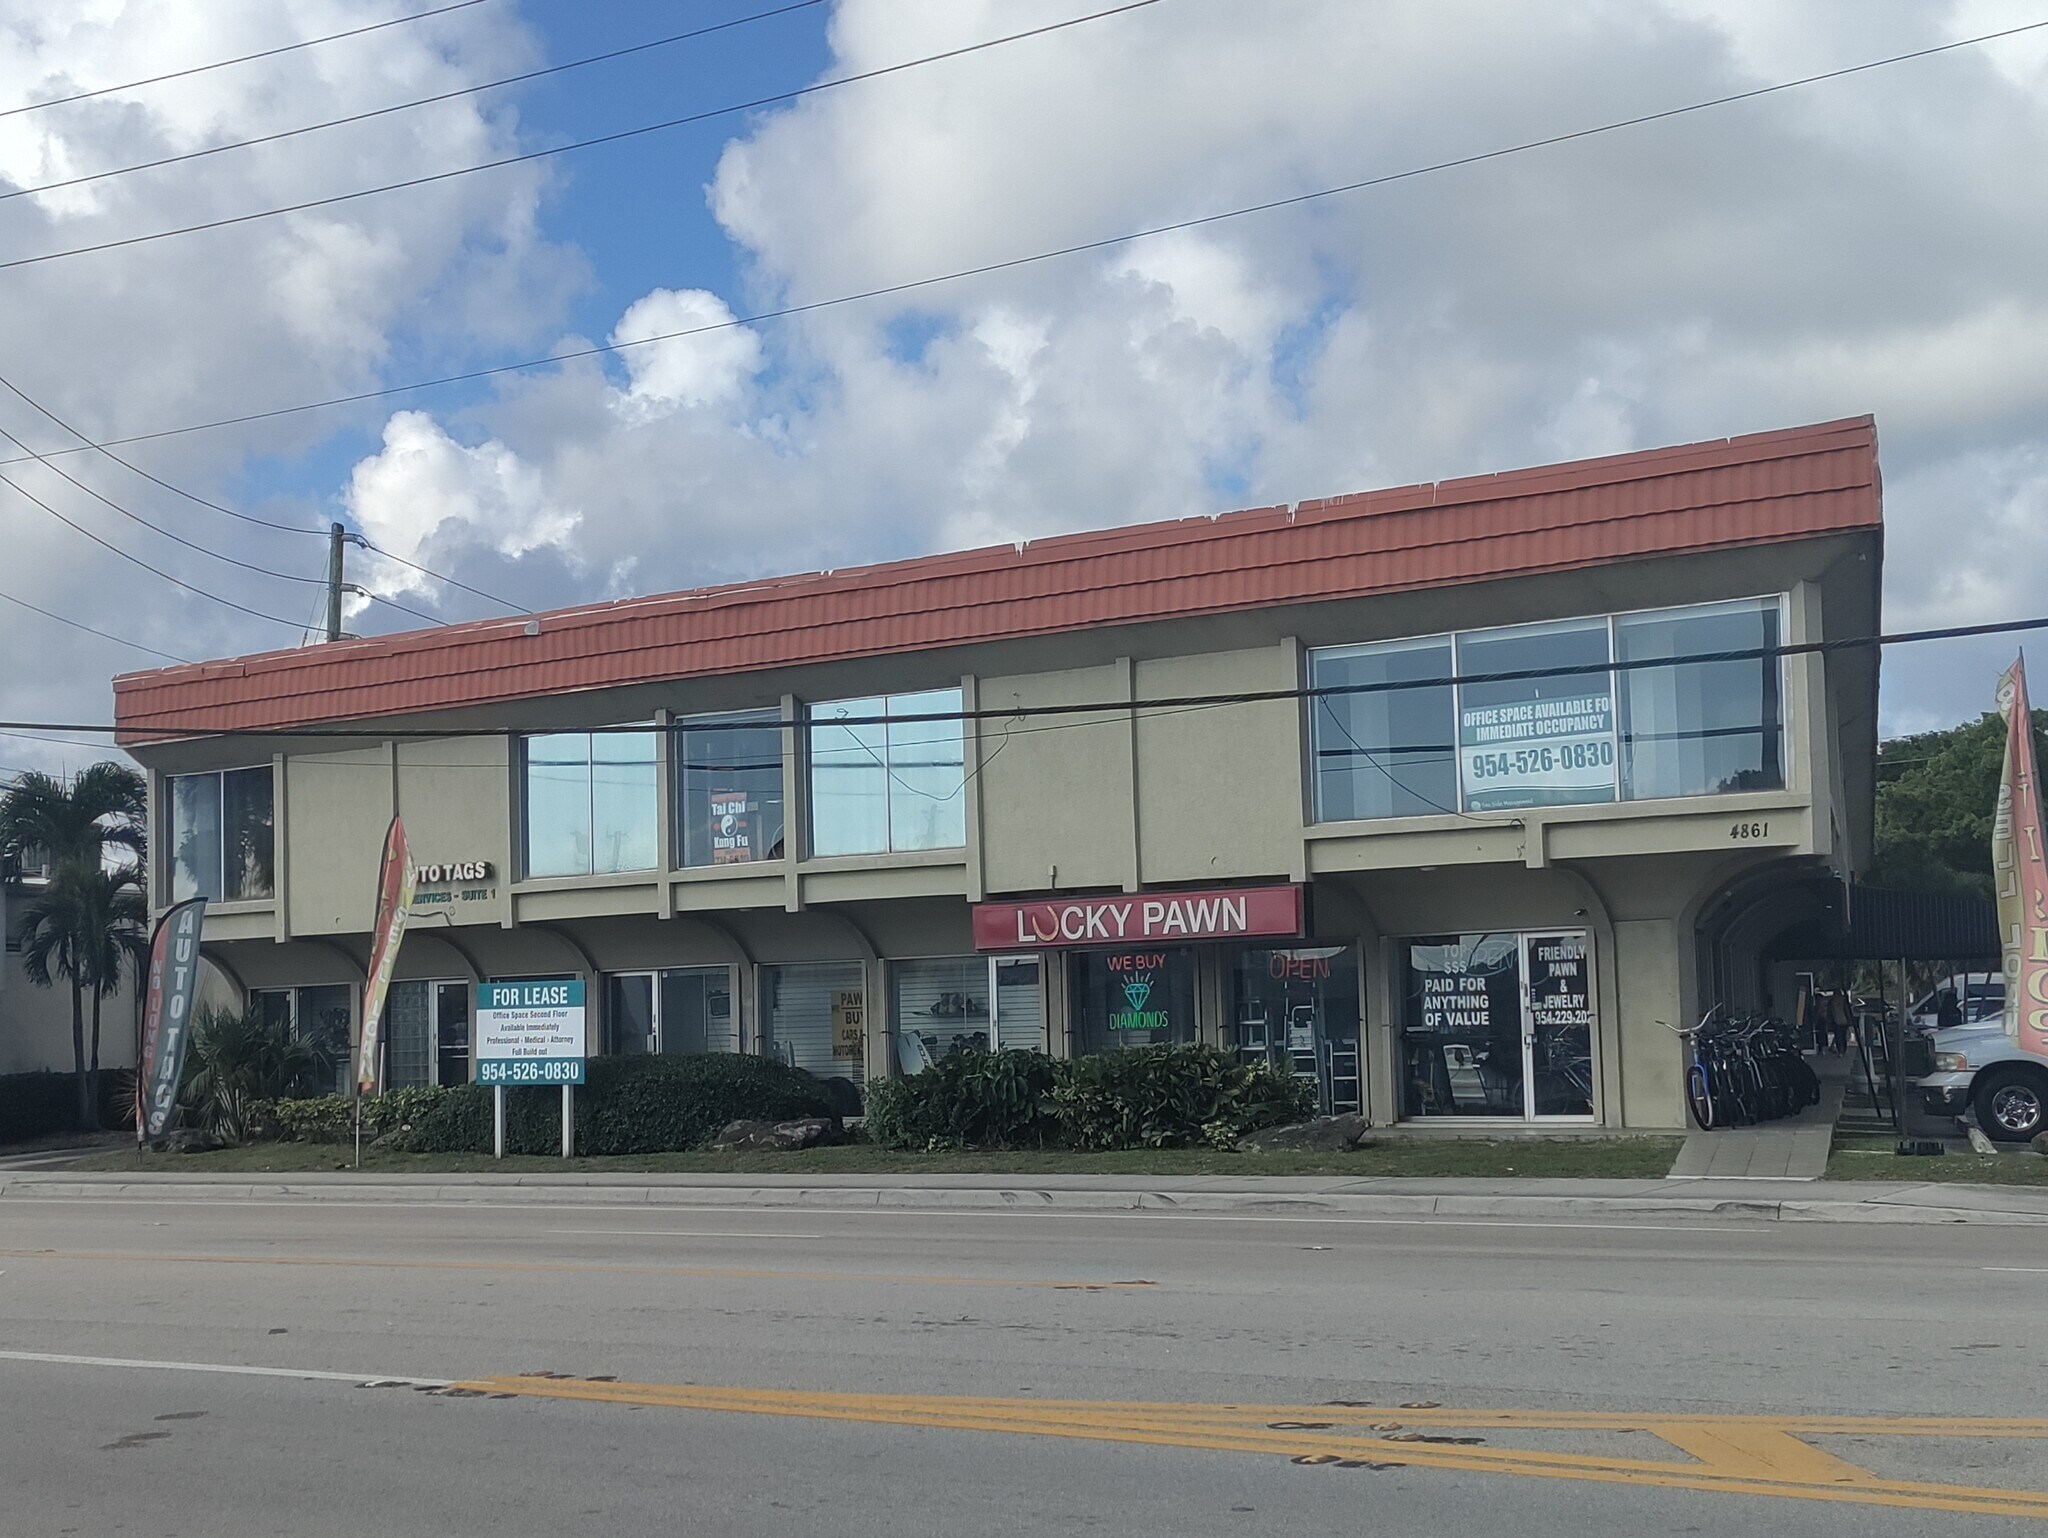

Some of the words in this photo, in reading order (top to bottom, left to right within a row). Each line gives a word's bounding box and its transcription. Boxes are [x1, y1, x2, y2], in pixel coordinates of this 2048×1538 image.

[1463, 709, 1498, 727] OFFICE
[1500, 705, 1533, 723] SPACE
[1535, 699, 1593, 718] AVAILABLE
[1595, 697, 1611, 712] FO
[1476, 722, 1535, 741] IMMEDIATE
[1536, 714, 1604, 735] OCCUPANCY
[1473, 741, 1613, 779] 954-526-0830
[711, 802, 727, 816] Tai
[728, 800, 746, 814] Chi
[1730, 822, 1768, 839] 4861
[714, 836, 735, 849] Kung
[736, 834, 749, 847] Fu
[443, 861, 486, 881] TAGS
[413, 891, 452, 904] ERVICES
[461, 889, 488, 901] SUITE
[490, 888, 496, 899] 1
[1017, 902, 1132, 942] LUCKY
[1143, 896, 1248, 937] PAWN
[1538, 945, 1587, 961] FRIENDLY
[169, 910, 194, 1019] AUTO
[1107, 956, 1132, 972] WE
[1135, 954, 1167, 970] BUY
[1269, 954, 1329, 979] OPEN
[1548, 962, 1578, 977] PAWN
[1425, 979, 1454, 992] PAID
[1459, 977, 1486, 992] FOR
[1560, 979, 1568, 992] &
[493, 988, 519, 1006] FOR
[524, 986, 568, 1005] LEASE
[1424, 995, 1489, 1010] ANYTHING
[1542, 994, 1585, 1009] JEWELRY
[493, 1011, 510, 1019] Office
[511, 1011, 528, 1020] Space
[530, 1010, 551, 1018] Second
[552, 1010, 568, 1018] Floor
[845, 1011, 863, 1024] BU
[1109, 1010, 1169, 1031] DIAMONDS
[1425, 1013, 1442, 1026] OF
[1444, 1011, 1490, 1026] VALUE
[500, 1024, 525, 1032] Available
[526, 1023, 559, 1032] Immediately
[841, 1028, 858, 1041] CARS
[487, 1036, 519, 1045] Professional
[524, 1036, 545, 1044] Medical
[551, 1036, 574, 1044] Attorney
[512, 1048, 522, 1056] Full
[482, 1062, 579, 1080] 954-526-0830
[148, 1027, 180, 1135] TAGS
